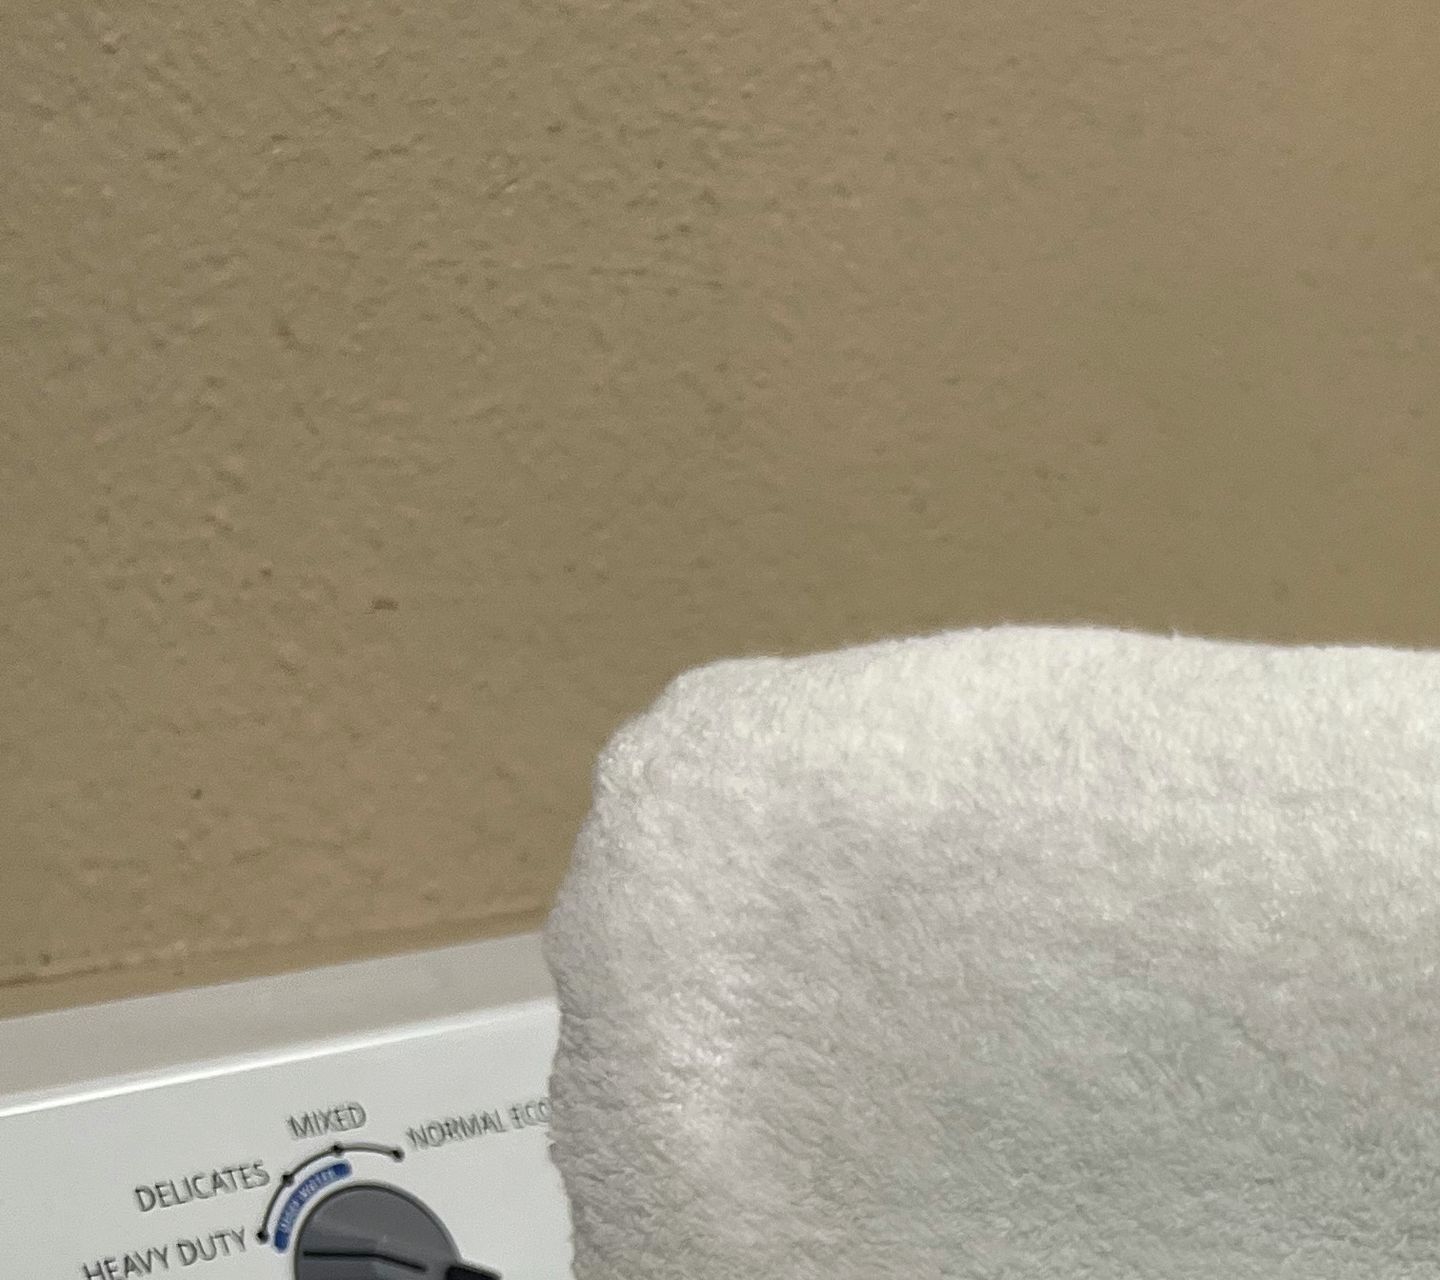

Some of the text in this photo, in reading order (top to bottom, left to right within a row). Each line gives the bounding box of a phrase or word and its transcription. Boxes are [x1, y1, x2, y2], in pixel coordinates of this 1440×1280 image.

[287, 1102, 367, 1139] MIXED
[406, 1109, 507, 1150] NORMAL
[135, 1161, 271, 1213] DELICATES
[176, 1228, 246, 1268] DUTY
